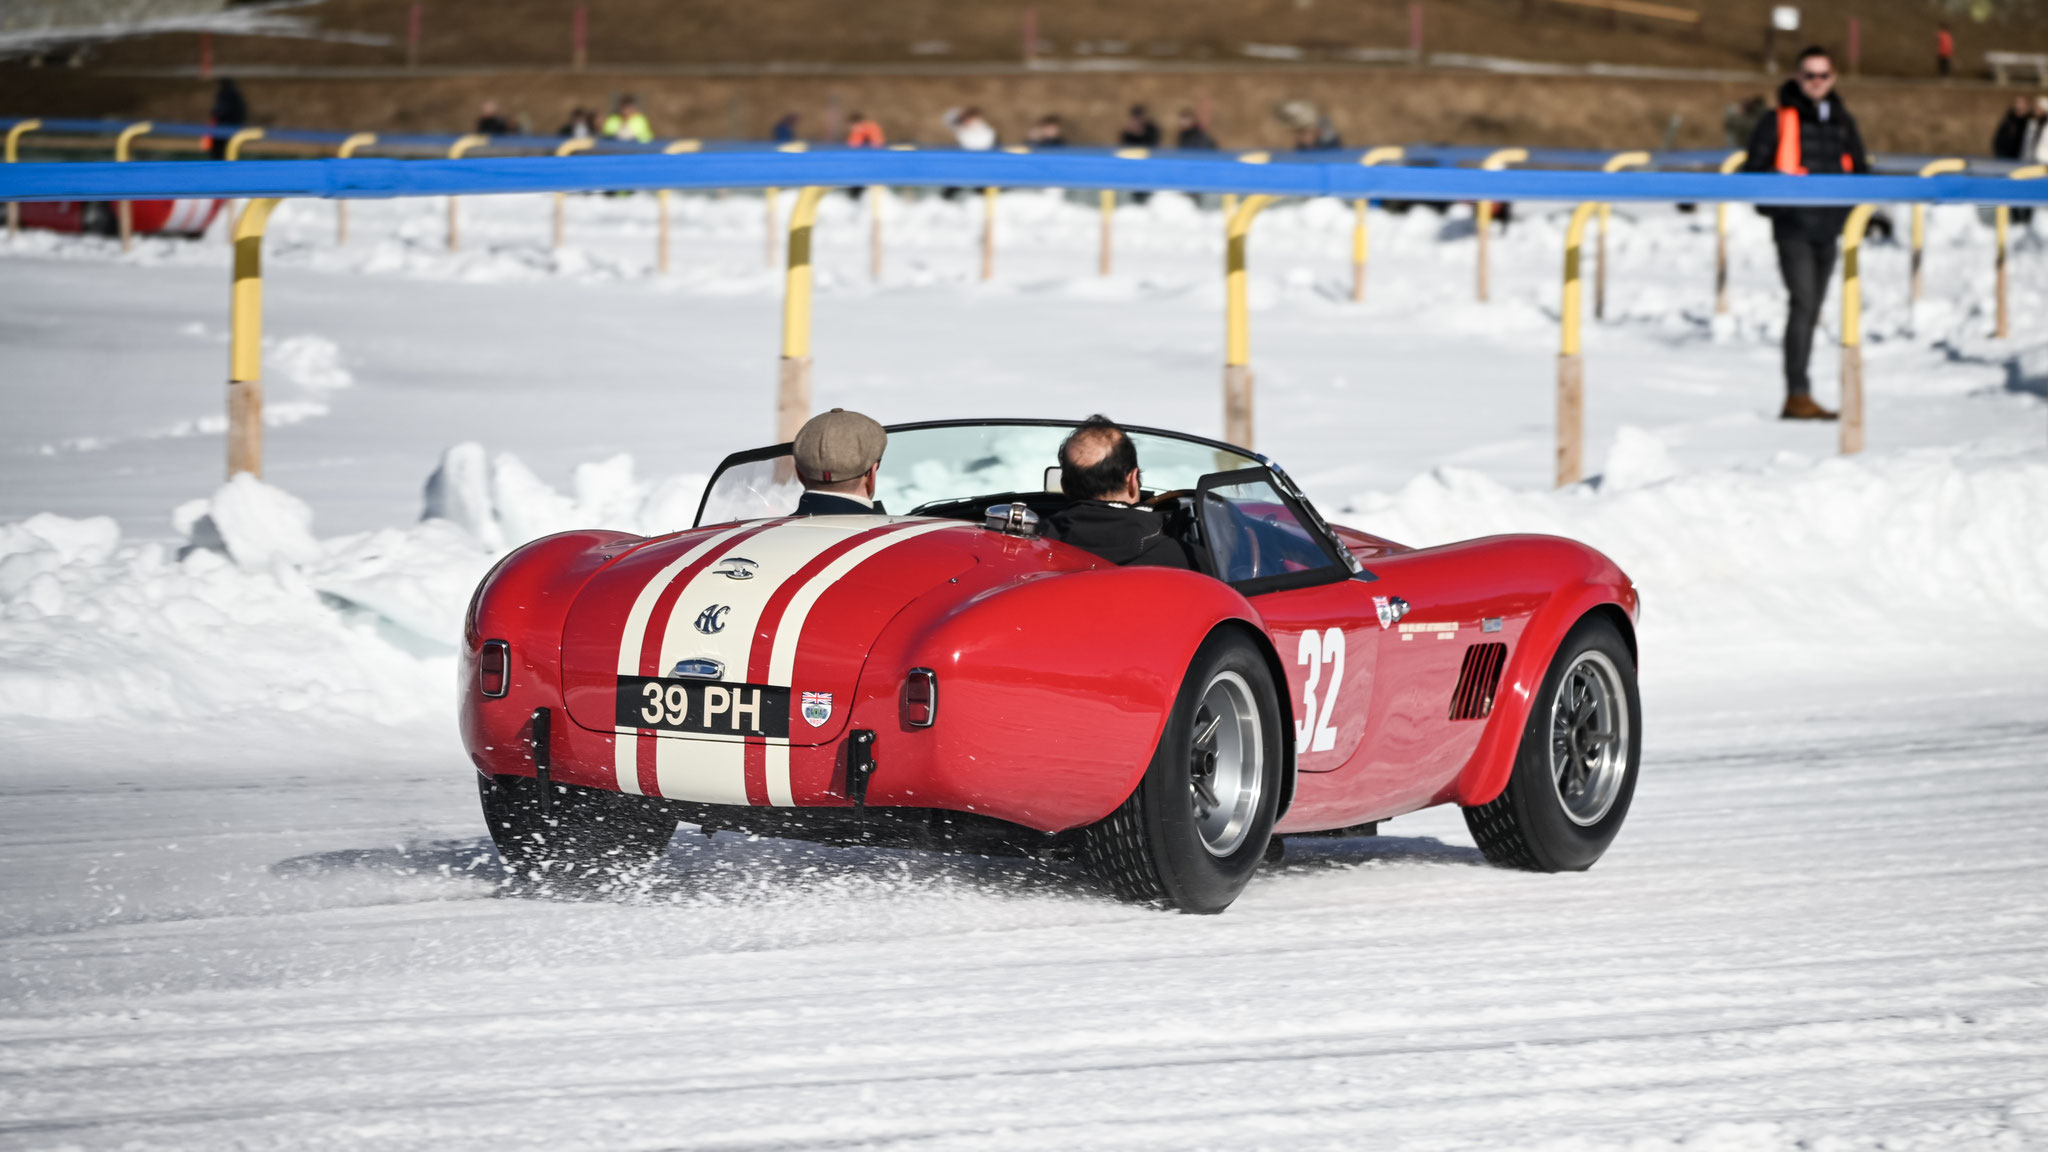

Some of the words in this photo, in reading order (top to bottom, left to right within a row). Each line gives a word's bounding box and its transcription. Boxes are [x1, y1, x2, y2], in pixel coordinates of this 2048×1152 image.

[694, 604, 731, 634] AC
[641, 682, 688, 726] 39
[703, 686, 761, 731] PH
[1295, 627, 1345, 754] 32
